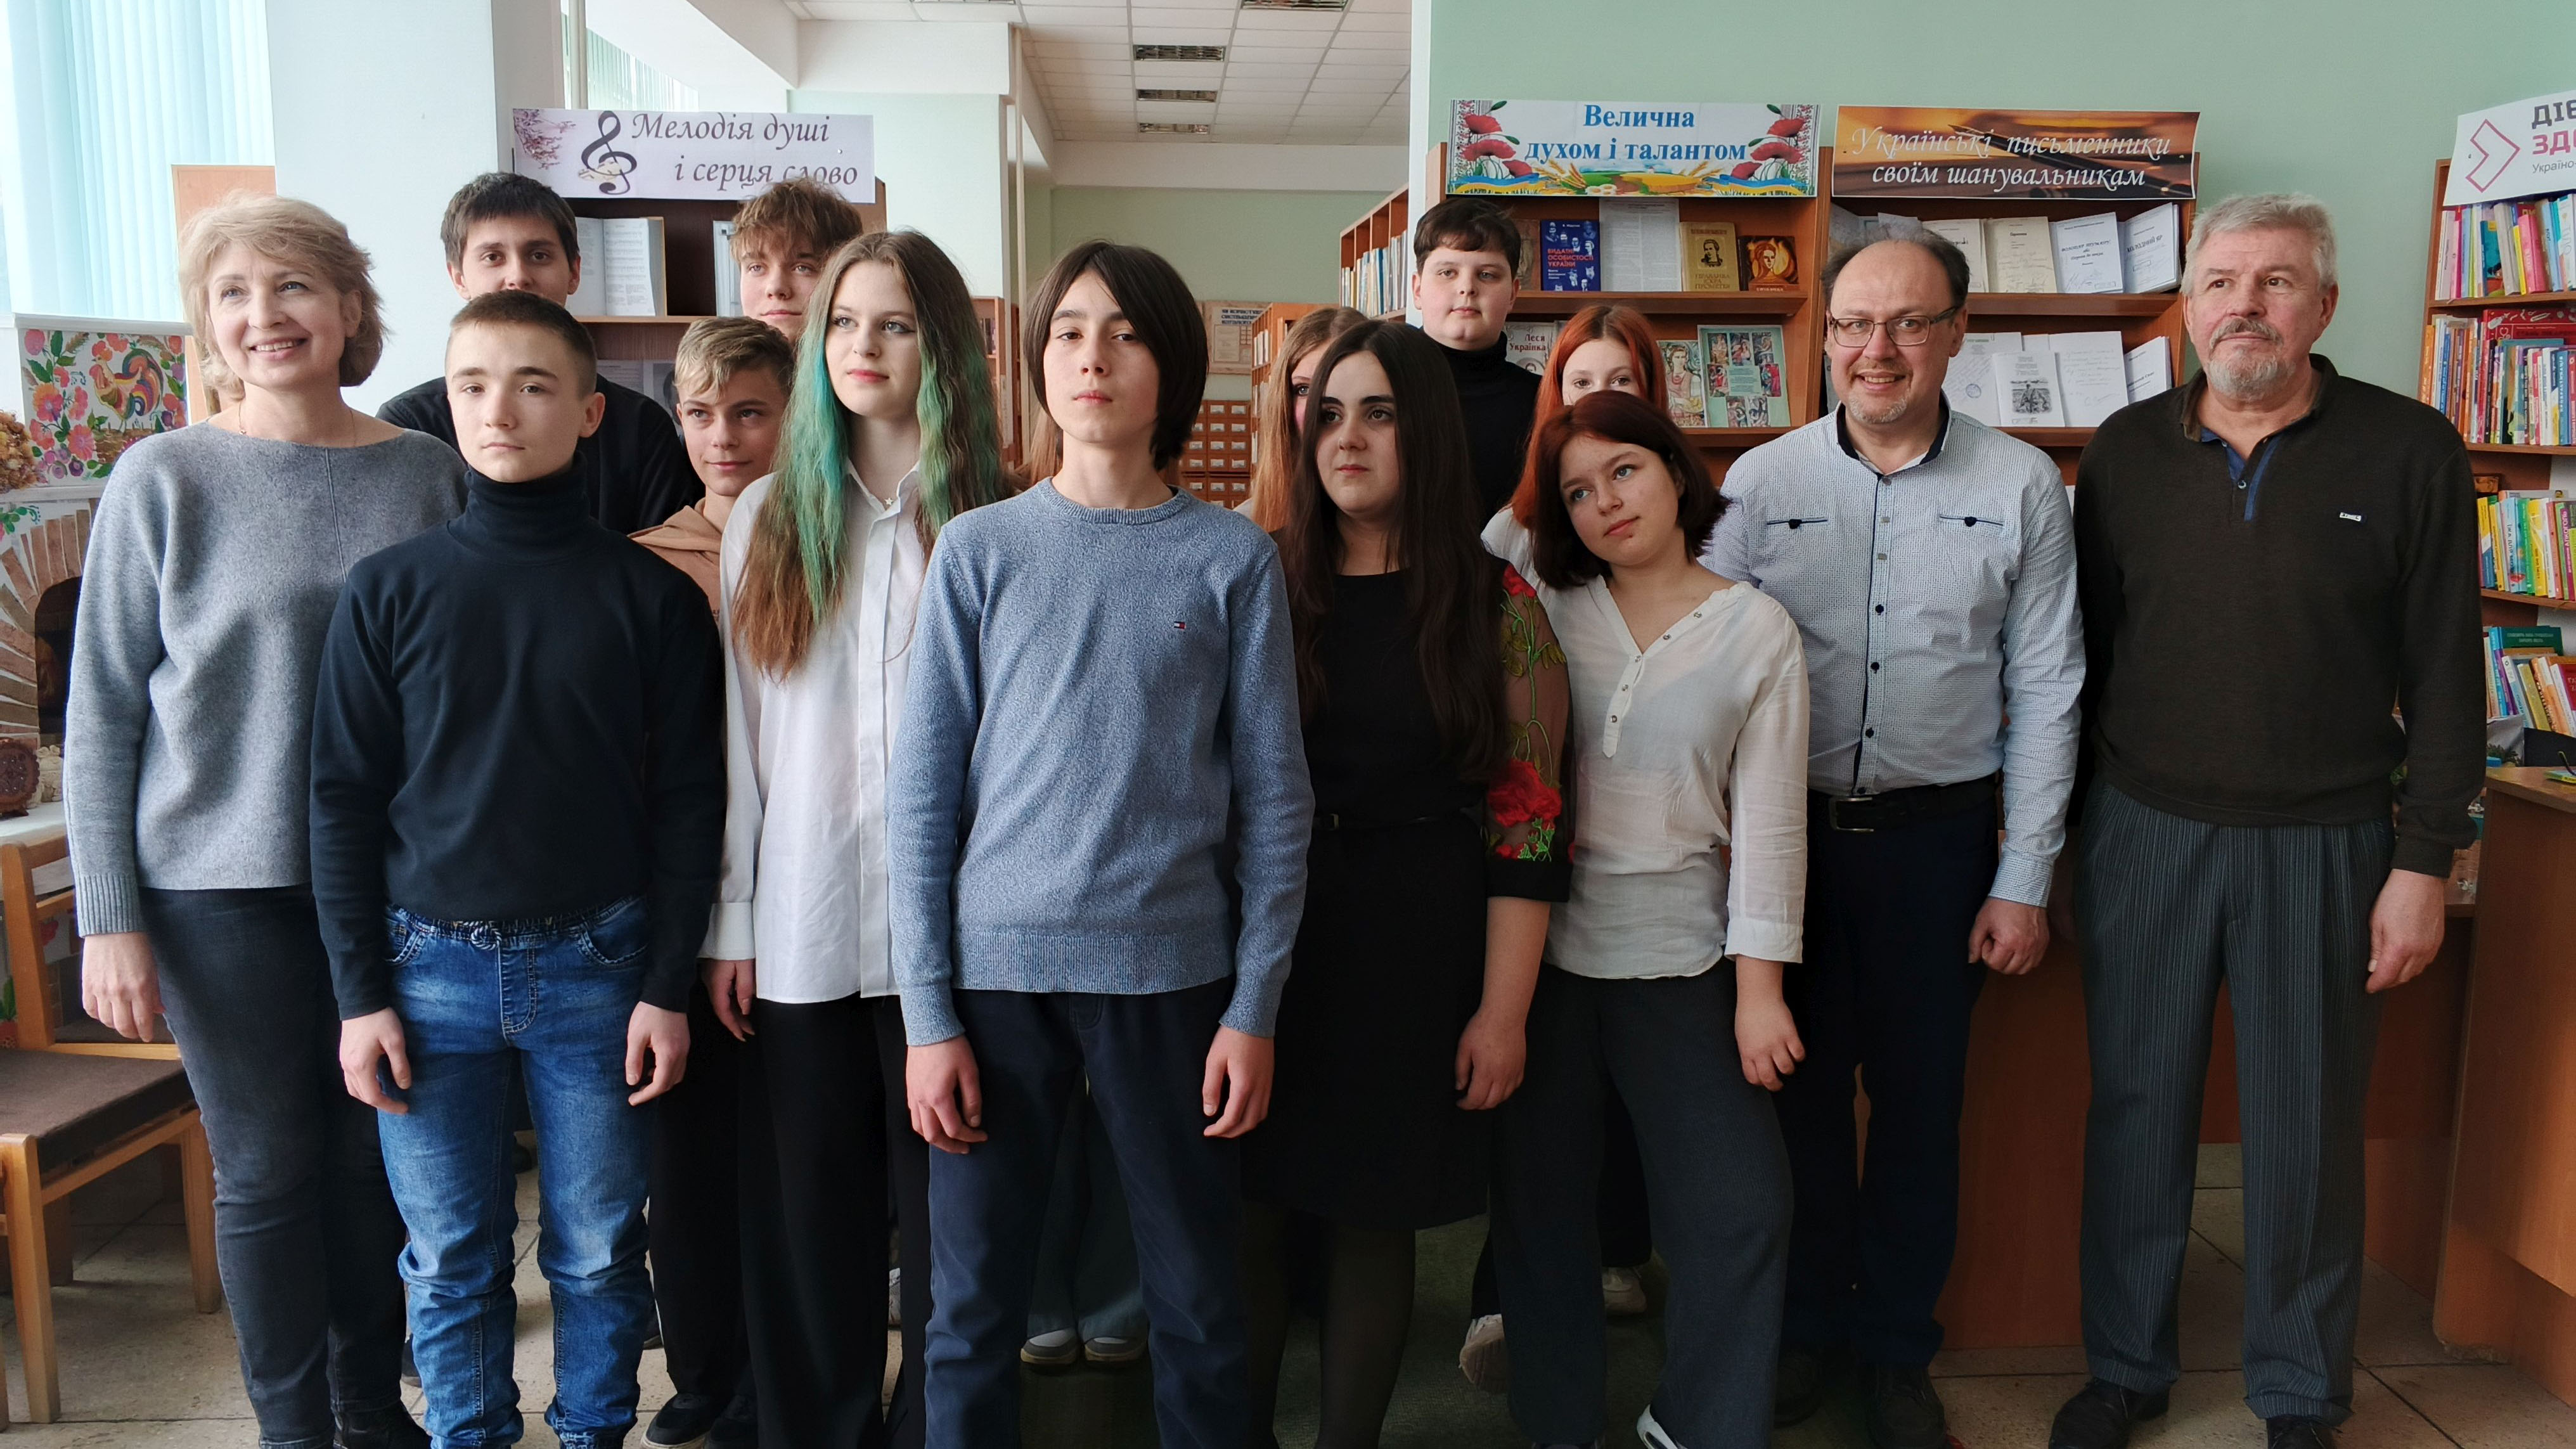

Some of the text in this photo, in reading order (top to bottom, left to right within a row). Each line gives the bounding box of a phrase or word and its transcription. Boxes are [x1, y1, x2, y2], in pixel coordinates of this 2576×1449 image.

[1583, 105, 1695, 127] Велична
[632, 112, 830, 150] Мелодія душі
[1852, 127, 2171, 160] Українські письменники
[2532, 130, 2576, 156] ЗД
[1524, 138, 1746, 164] духом і талантом
[675, 155, 685, 181] і
[693, 163, 772, 191] серця
[1872, 163, 2145, 192] своїм шанувальникам
[1509, 342, 1547, 352] Українка
[1524, 333, 1545, 342] Леся
